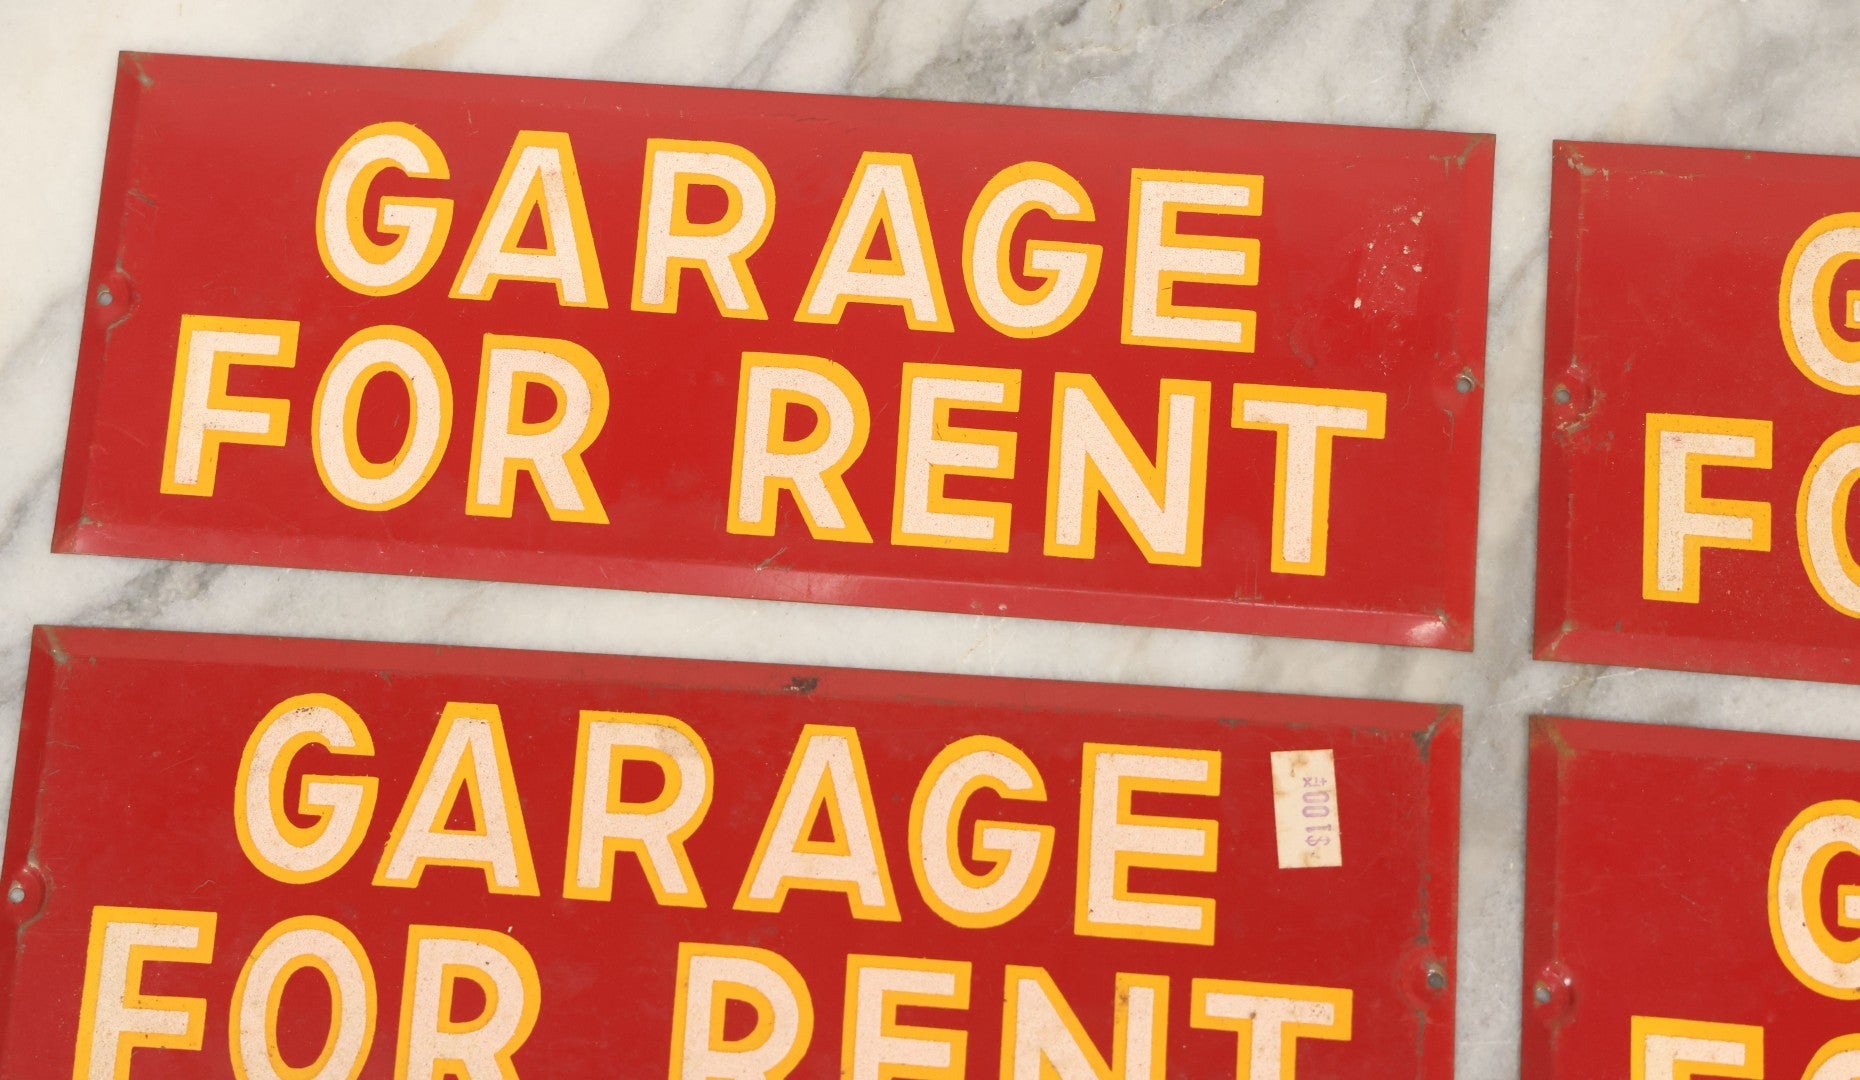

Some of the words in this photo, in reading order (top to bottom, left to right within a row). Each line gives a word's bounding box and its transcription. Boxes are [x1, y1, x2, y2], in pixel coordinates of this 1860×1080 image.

[316, 121, 1264, 353] GARAGE
[160, 314, 610, 524] FOR
[726, 352, 1387, 576] RENT
[234, 693, 1221, 946] GARAGE
[72, 906, 541, 1080] FOR
[668, 942, 1353, 1080] RENT
